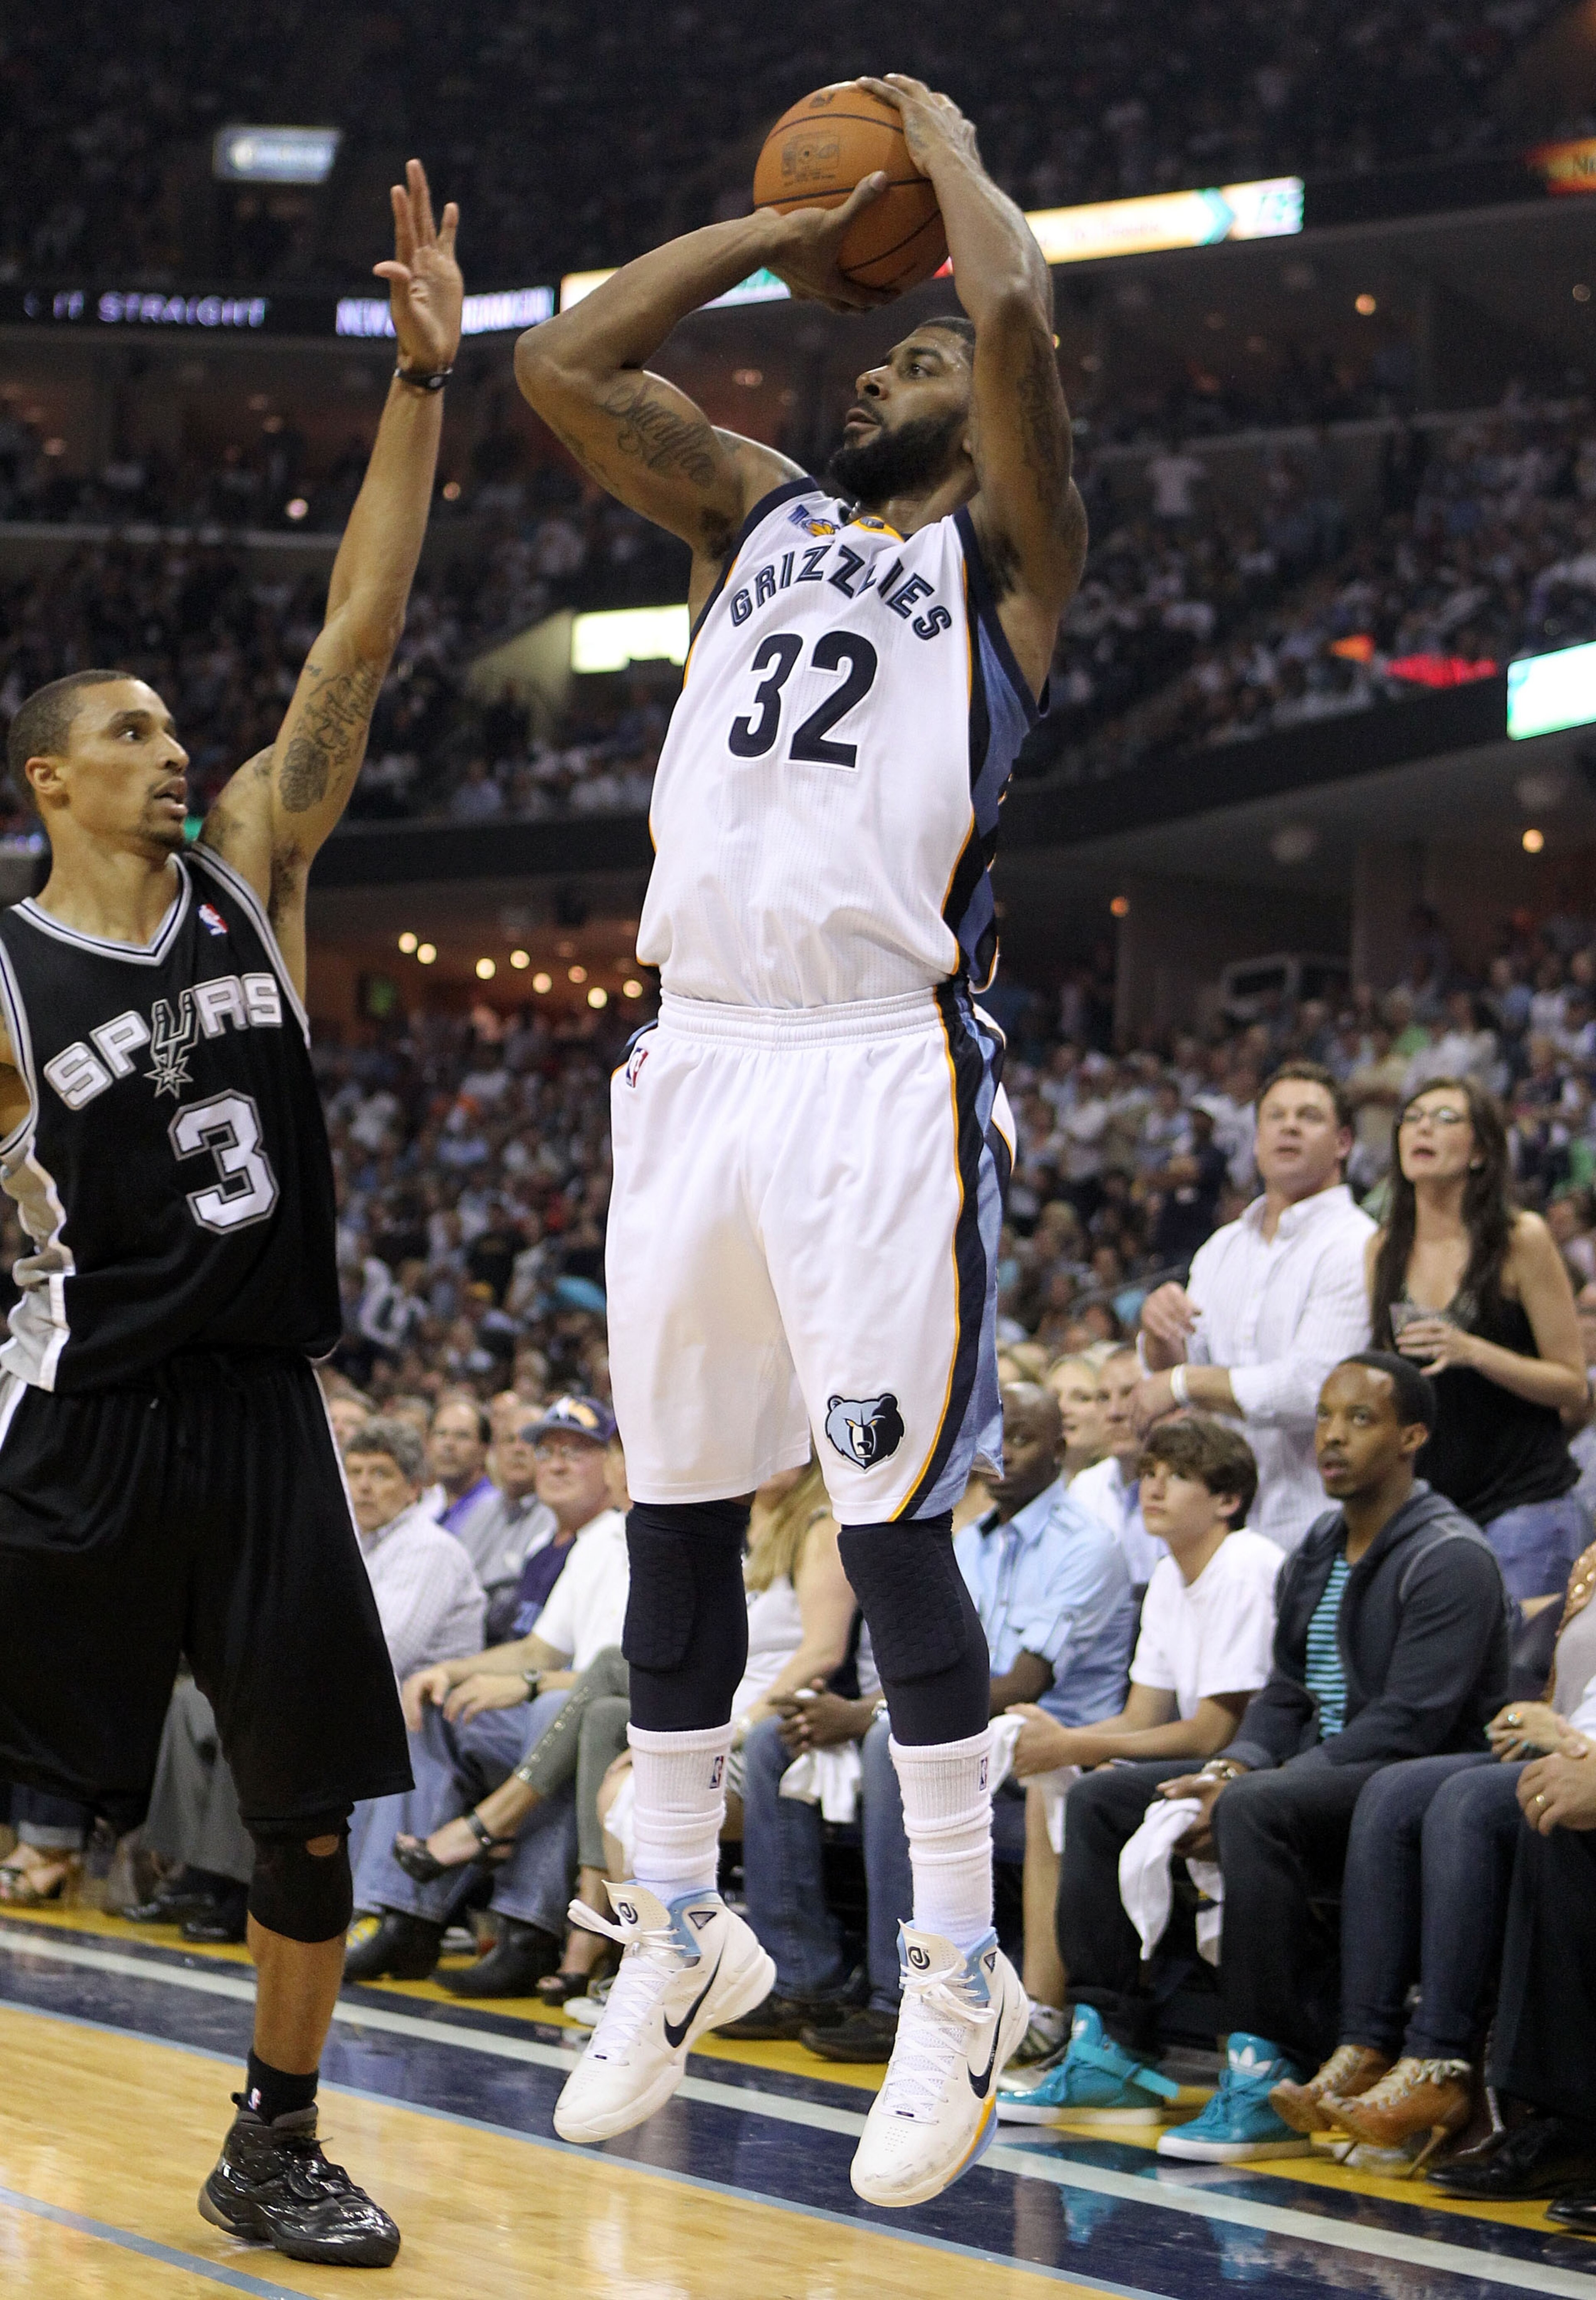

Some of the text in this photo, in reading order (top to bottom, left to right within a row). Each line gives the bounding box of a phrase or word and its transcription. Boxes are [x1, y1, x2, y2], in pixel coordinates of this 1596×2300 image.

[53, 291, 84, 320] IT
[98, 291, 267, 328] STRAIGHT
[727, 629, 879, 769] 32
[43, 972, 283, 1111] SPURS
[167, 1088, 280, 1235] 3
